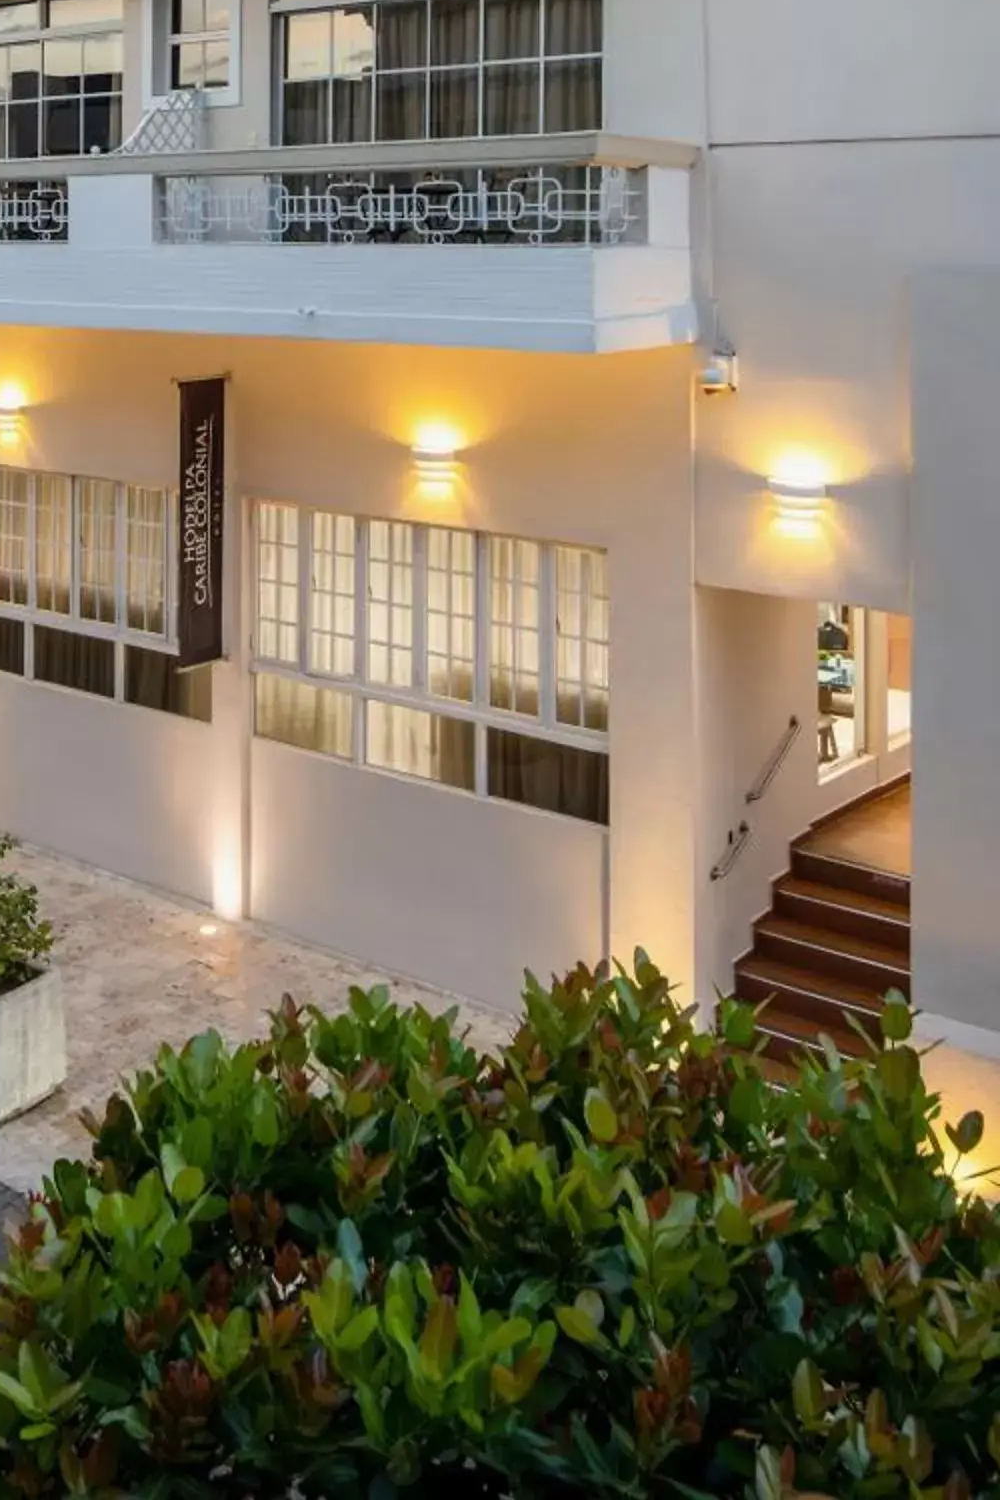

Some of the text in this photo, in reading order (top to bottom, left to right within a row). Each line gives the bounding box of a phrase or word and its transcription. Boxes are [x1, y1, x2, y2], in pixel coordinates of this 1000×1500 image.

[183, 463, 196, 563] HODELPA
[194, 419, 208, 606] CARIBE COLONIAL
